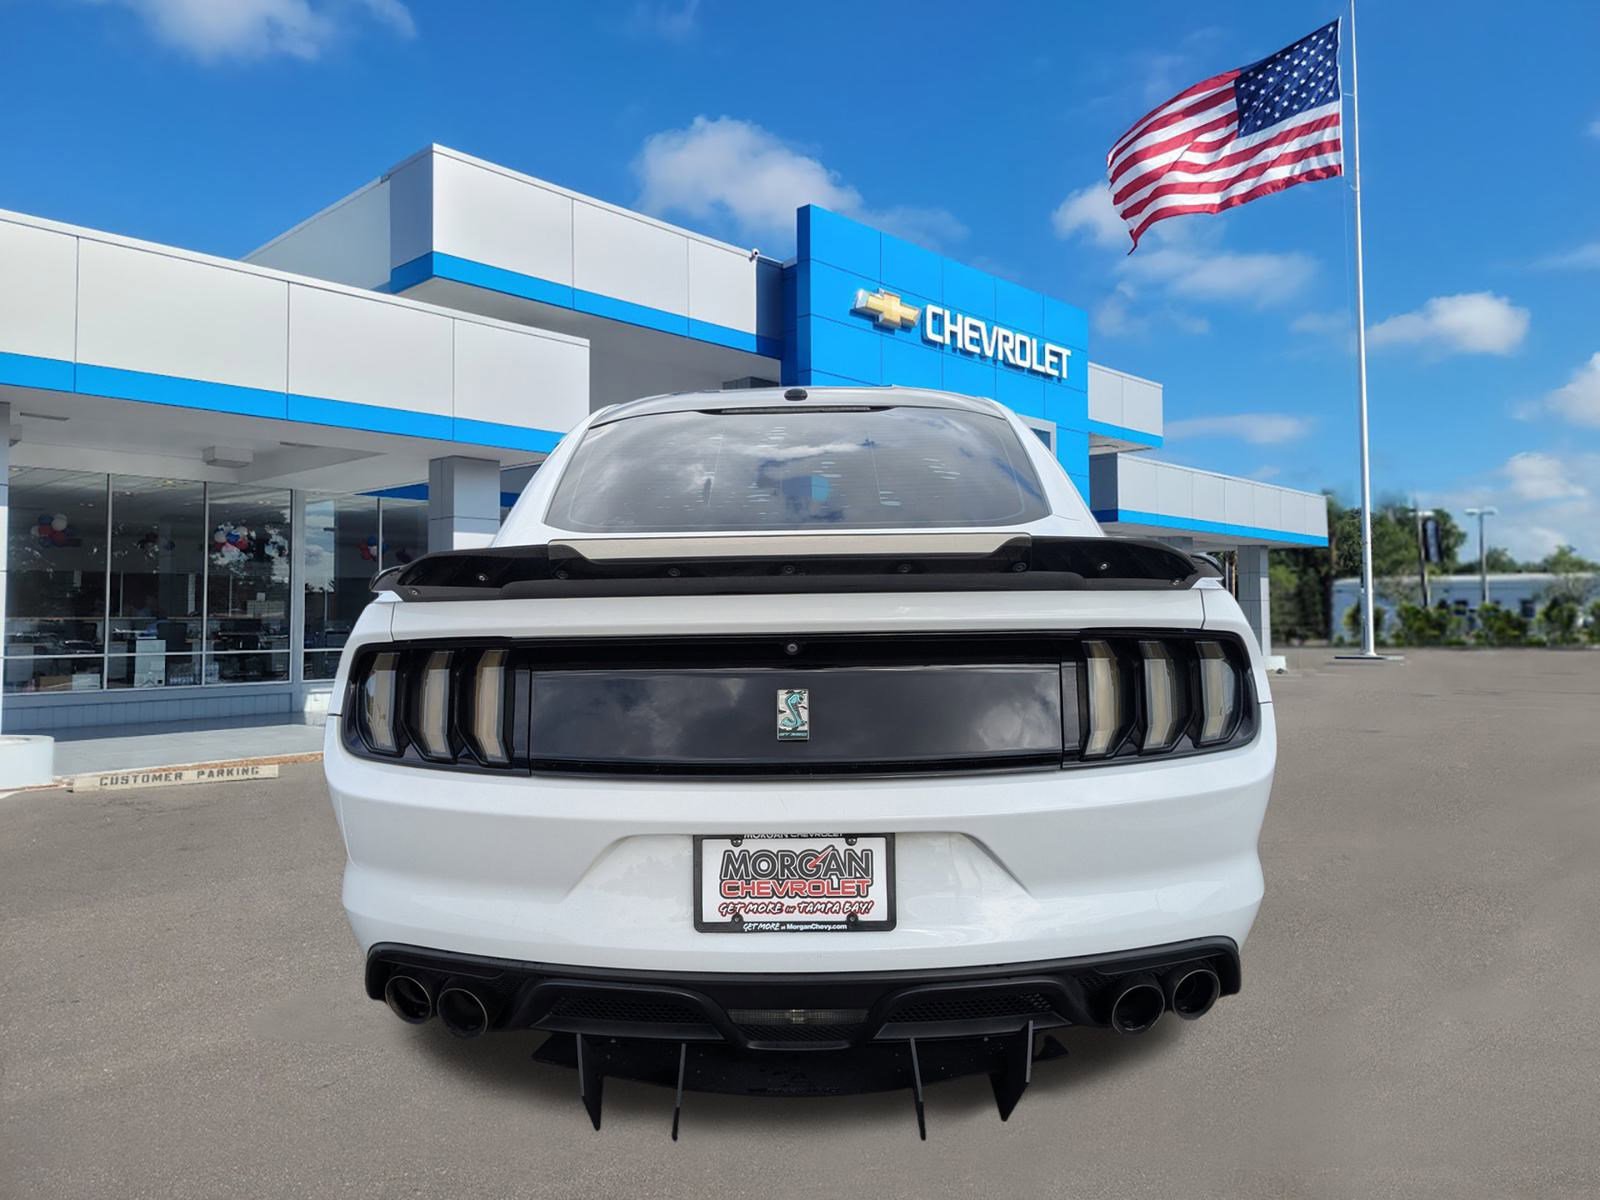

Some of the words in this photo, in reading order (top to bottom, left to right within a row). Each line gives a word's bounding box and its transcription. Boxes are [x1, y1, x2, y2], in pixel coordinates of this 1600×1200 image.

[926, 304, 1072, 379] CHEVROLET
[100, 772, 183, 786] CUSTOMER
[197, 767, 260, 779] PARKING
[720, 846, 873, 880] MORGAN
[722, 880, 873, 897] CHEVROLET
[718, 902, 744, 916] GET
[744, 902, 784, 914] MORE
[798, 901, 840, 914] TAMPA
[842, 900, 874, 914] BAY!
[743, 922, 758, 932] GET
[758, 922, 780, 931] MORE
[786, 923, 848, 931] MorganChevy.com
